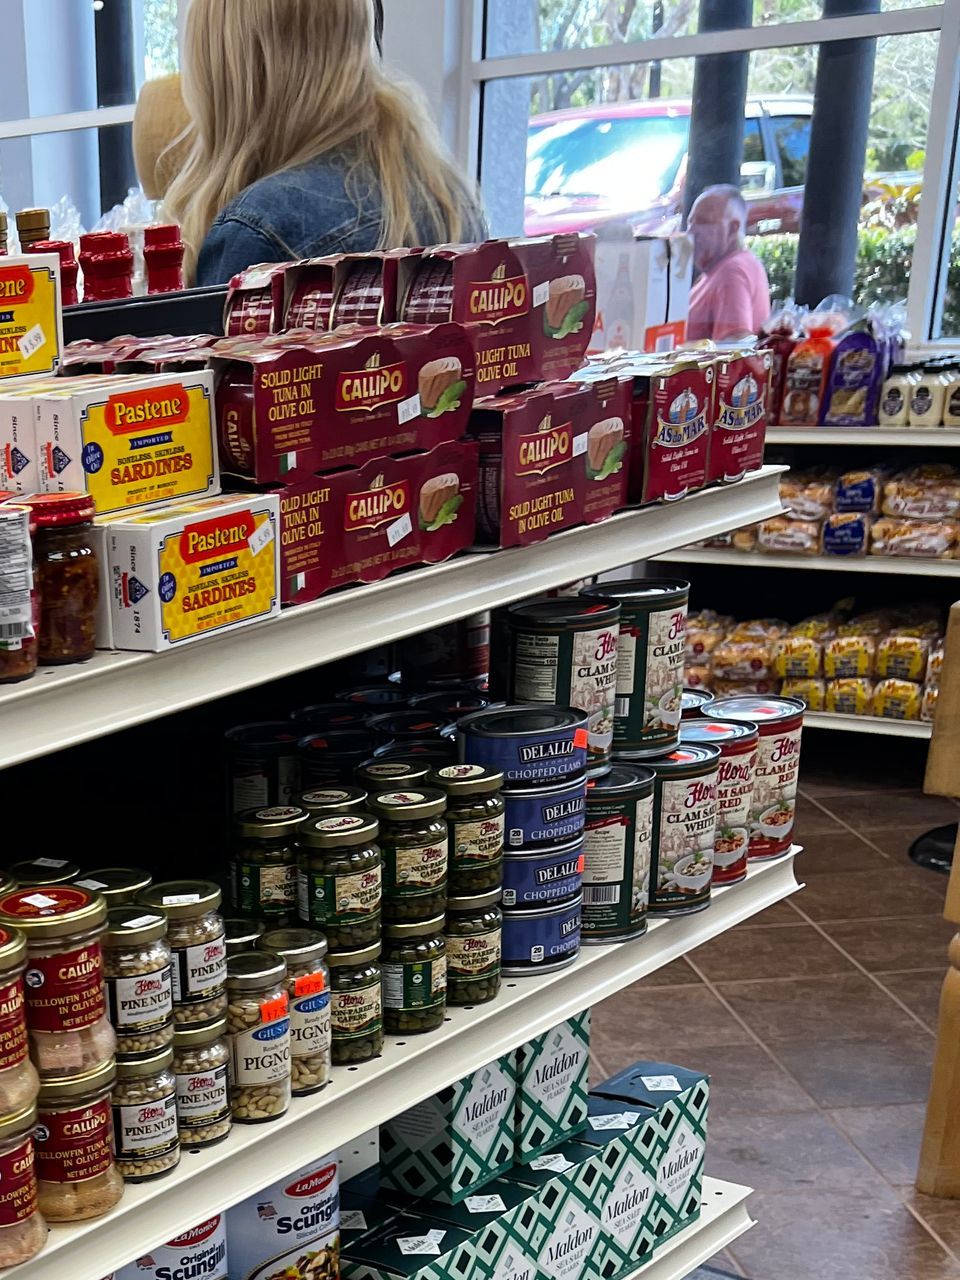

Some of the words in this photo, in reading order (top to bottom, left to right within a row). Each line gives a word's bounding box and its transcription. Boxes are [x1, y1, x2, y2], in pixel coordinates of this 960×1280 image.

[470, 281, 526, 314] CALLIPO
[481, 347, 506, 365] LIGHT
[507, 343, 531, 360] TUNA
[261, 368, 291, 389] SOLID
[293, 363, 324, 385] LIGHT
[476, 364, 501, 384] OLIVE
[502, 362, 518, 378] OIL
[272, 384, 298, 404] TUNA
[301, 382, 311, 398] IN
[341, 369, 403, 401] CALLIPO
[113, 398, 181, 425] Pastene
[268, 401, 297, 422] OLIVE
[298, 399, 316, 414] OIL
[133, 434, 170, 447] IMPORTED
[519, 431, 569, 466] CALLIPO
[110, 453, 193, 486] SARDINES
[301, 487, 331, 508] LIGHT
[349, 488, 406, 522] CALLIPO
[508, 501, 531, 521] SOLID
[531, 493, 554, 515] LIGHT
[554, 488, 575, 505] TUNA
[283, 509, 307, 529] TUNA
[309, 506, 320, 521] IN
[517, 519, 527, 535] IN
[527, 511, 550, 531] OLIVE
[551, 507, 565, 523] OIL
[188, 524, 248, 554] Pastene
[281, 525, 306, 546] OLIVE
[307, 521, 325, 537] OIL
[203, 560, 236, 574] IMPORTED
[182, 577, 257, 613] SARDINES
[133, 610, 141, 634] 1874
[652, 643, 680, 658] CLAM
[577, 662, 609, 678] CLAM
[522, 740, 575, 762] DELALLO
[507, 765, 556, 780] CHOPPED
[558, 761, 583, 776] CLAMS
[754, 763, 788, 777] CLAM
[777, 770, 797, 785] RED
[719, 797, 742, 810] RED
[666, 811, 700, 824] CLAM
[530, 823, 573, 841] CHOPPED
[523, 885, 567, 902] CHOPPED
[190, 963, 215, 978] PINE
[461, 955, 490, 966] CAPERS
[71, 999, 95, 1012] OLIVE
[121, 997, 149, 1011] PINE
[150, 987, 172, 1006] NUTS
[337, 1012, 368, 1024] CAPERS
[532, 1051, 580, 1089] Maldon
[201, 1085, 226, 1102] NUTS
[463, 1088, 508, 1127] Maldon
[62, 1112, 107, 1137] CALLIPO
[125, 1122, 153, 1137] PINE
[154, 1115, 175, 1133] NUTS
[87, 1140, 106, 1153] TUNA
[63, 1157, 73, 1168] IN
[76, 1152, 100, 1166] OLIVE
[660, 1148, 699, 1184] Maldon
[605, 1187, 650, 1223] Maldon
[179, 1243, 217, 1266] Original
[545, 1226, 595, 1266] Maldon
